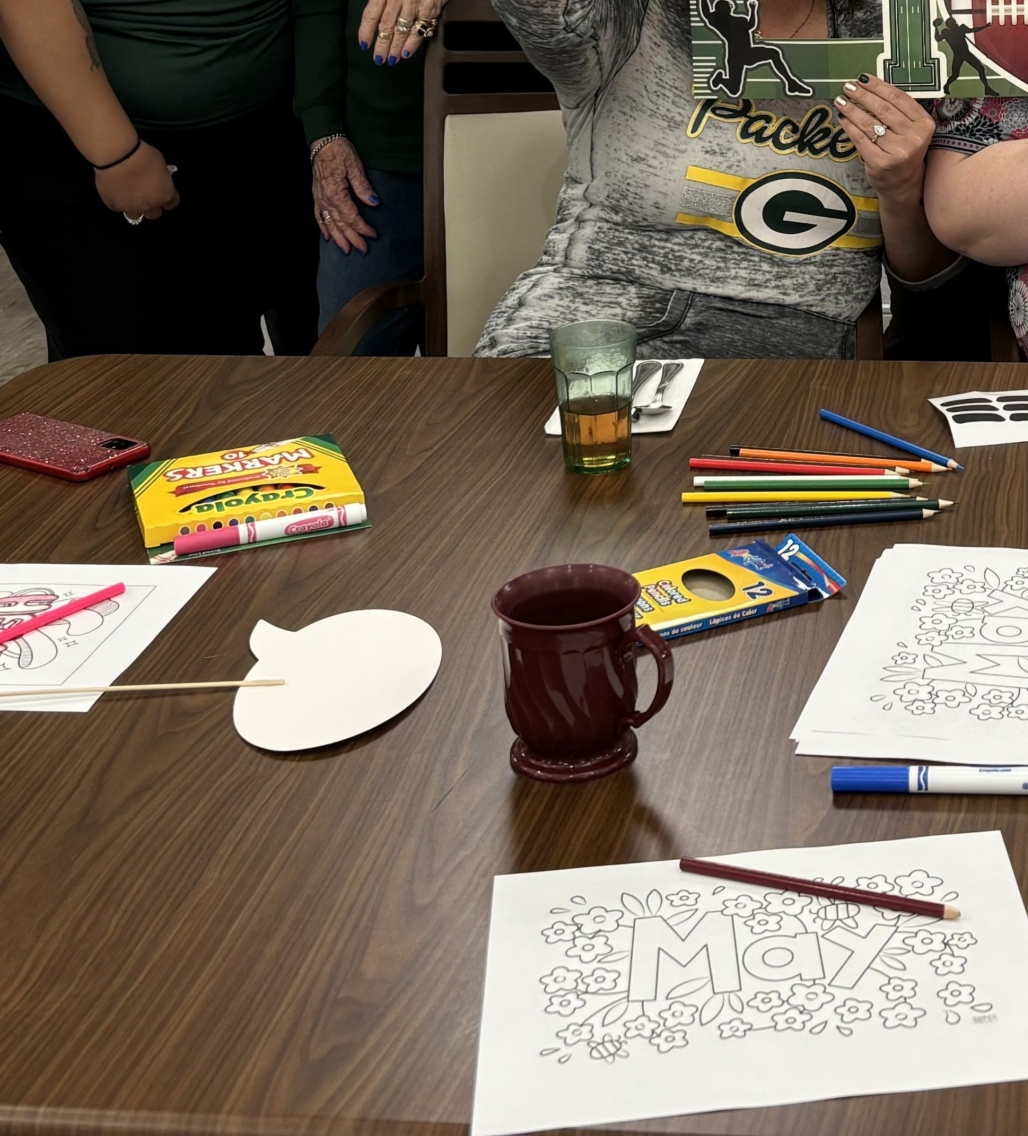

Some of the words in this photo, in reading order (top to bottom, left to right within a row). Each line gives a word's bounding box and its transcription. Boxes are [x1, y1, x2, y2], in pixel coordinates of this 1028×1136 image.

[686, 98, 861, 162] Packe
[736, 173, 853, 254] G
[163, 448, 315, 482] MARKERS
[223, 451, 247, 460] 10
[194, 487, 315, 513] Crayola
[288, 517, 331, 535] Crayola
[778, 539, 799, 560] 12
[642, 584, 672, 606] Pencils
[656, 580, 691, 603] Colored
[742, 581, 774, 600] 12
[742, 607, 758, 619] Color
[627, 909, 902, 1003] May
